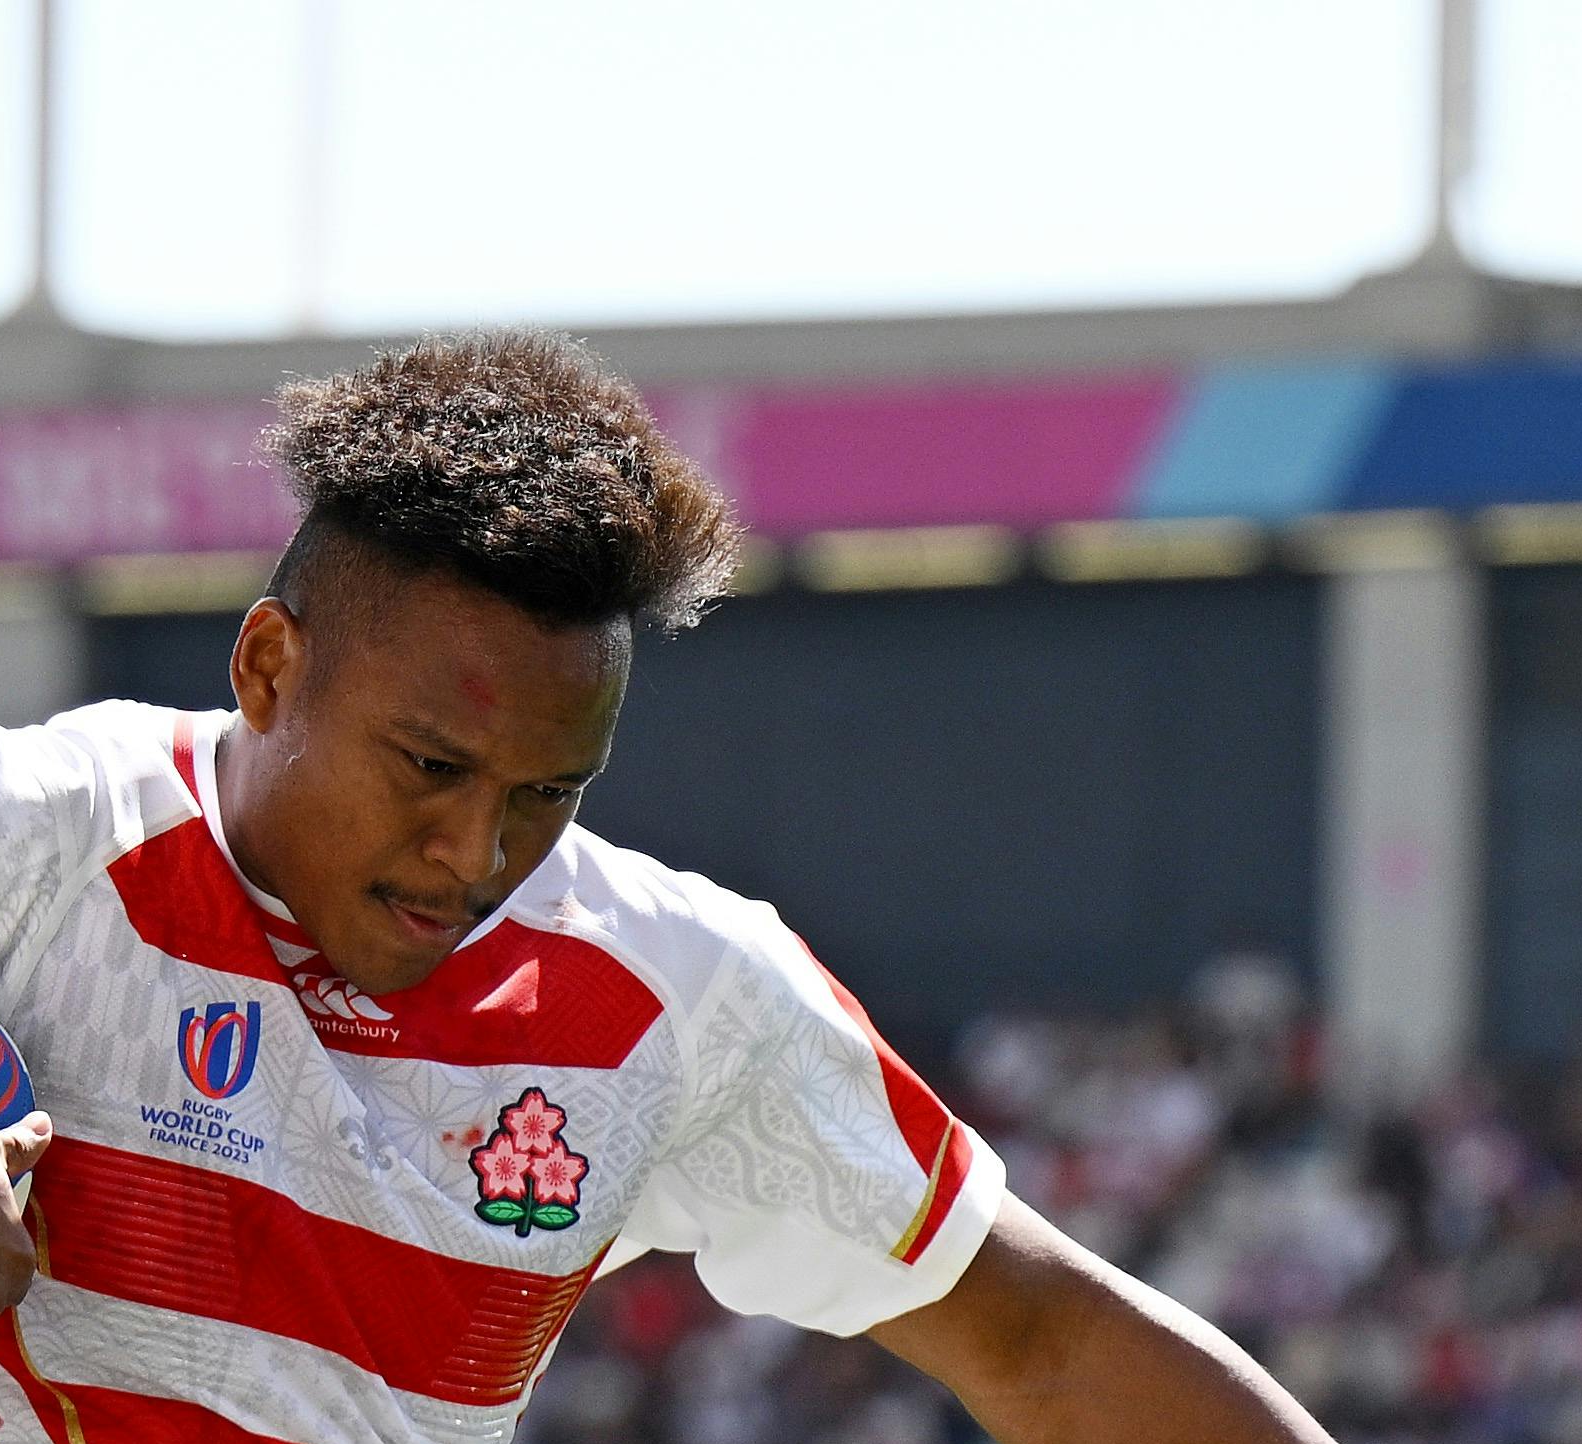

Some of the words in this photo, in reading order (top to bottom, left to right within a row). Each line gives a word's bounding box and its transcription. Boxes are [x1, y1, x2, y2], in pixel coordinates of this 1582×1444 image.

[308, 1019, 400, 1042] anterbury
[182, 1099, 233, 1122] RUGBY
[140, 1105, 223, 1139] WORLD
[227, 1130, 265, 1153] CUP
[149, 1127, 209, 1154] FRANCE
[212, 1143, 250, 1164] 2023
